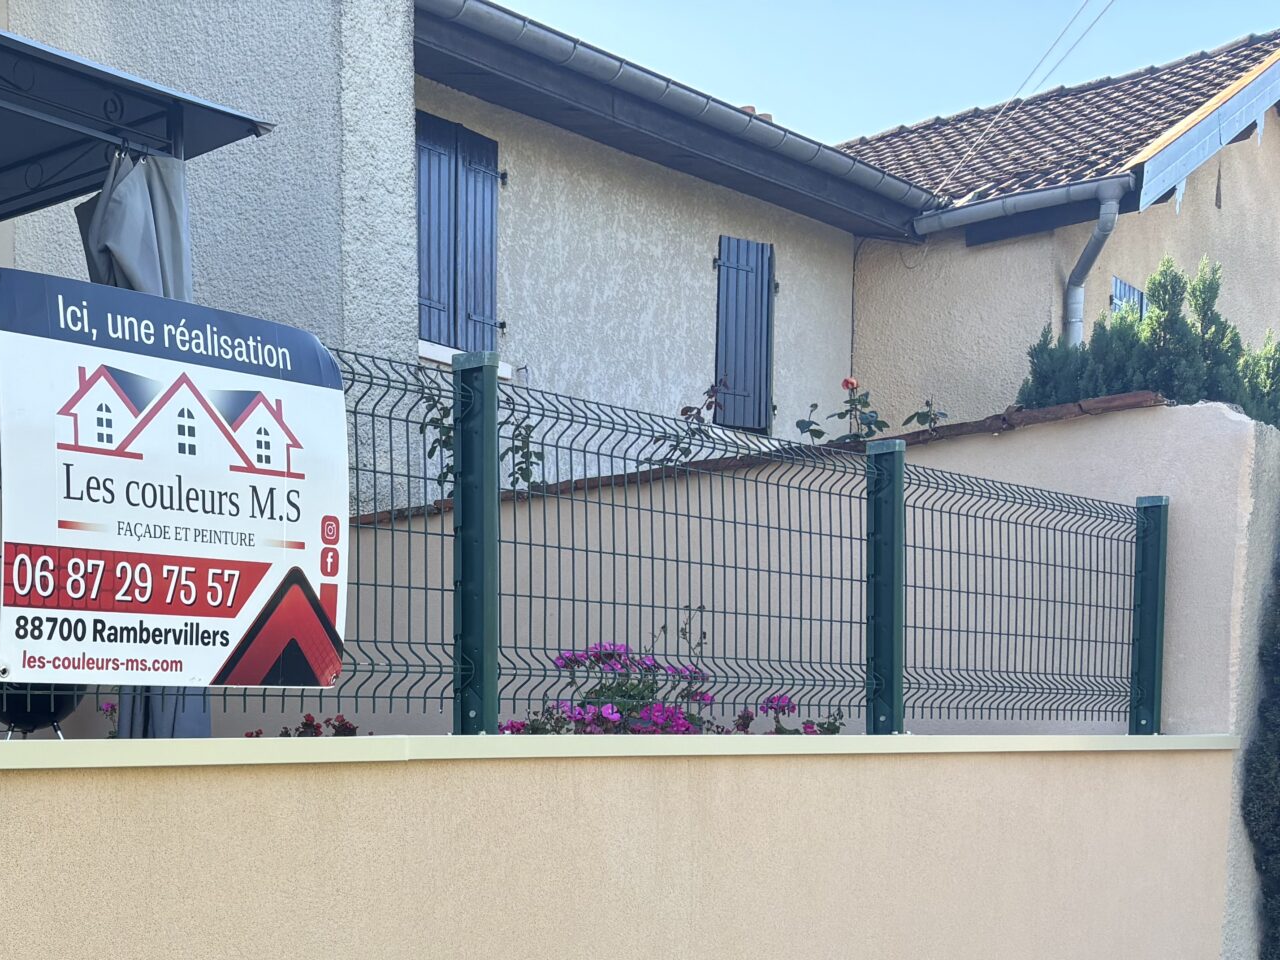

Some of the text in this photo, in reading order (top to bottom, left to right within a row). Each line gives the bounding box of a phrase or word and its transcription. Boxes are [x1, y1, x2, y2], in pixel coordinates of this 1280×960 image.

[58, 295, 292, 371] Ici, une réalisation
[63, 462, 301, 523] Les couleurs M.S
[117, 520, 256, 547] FAÇADE ET PEINTURE
[12, 553, 240, 607] 06 87 29 75 57
[14, 615, 230, 647] 88700 Rambervillers
[22, 650, 183, 672] les-couleurs-ms.com
